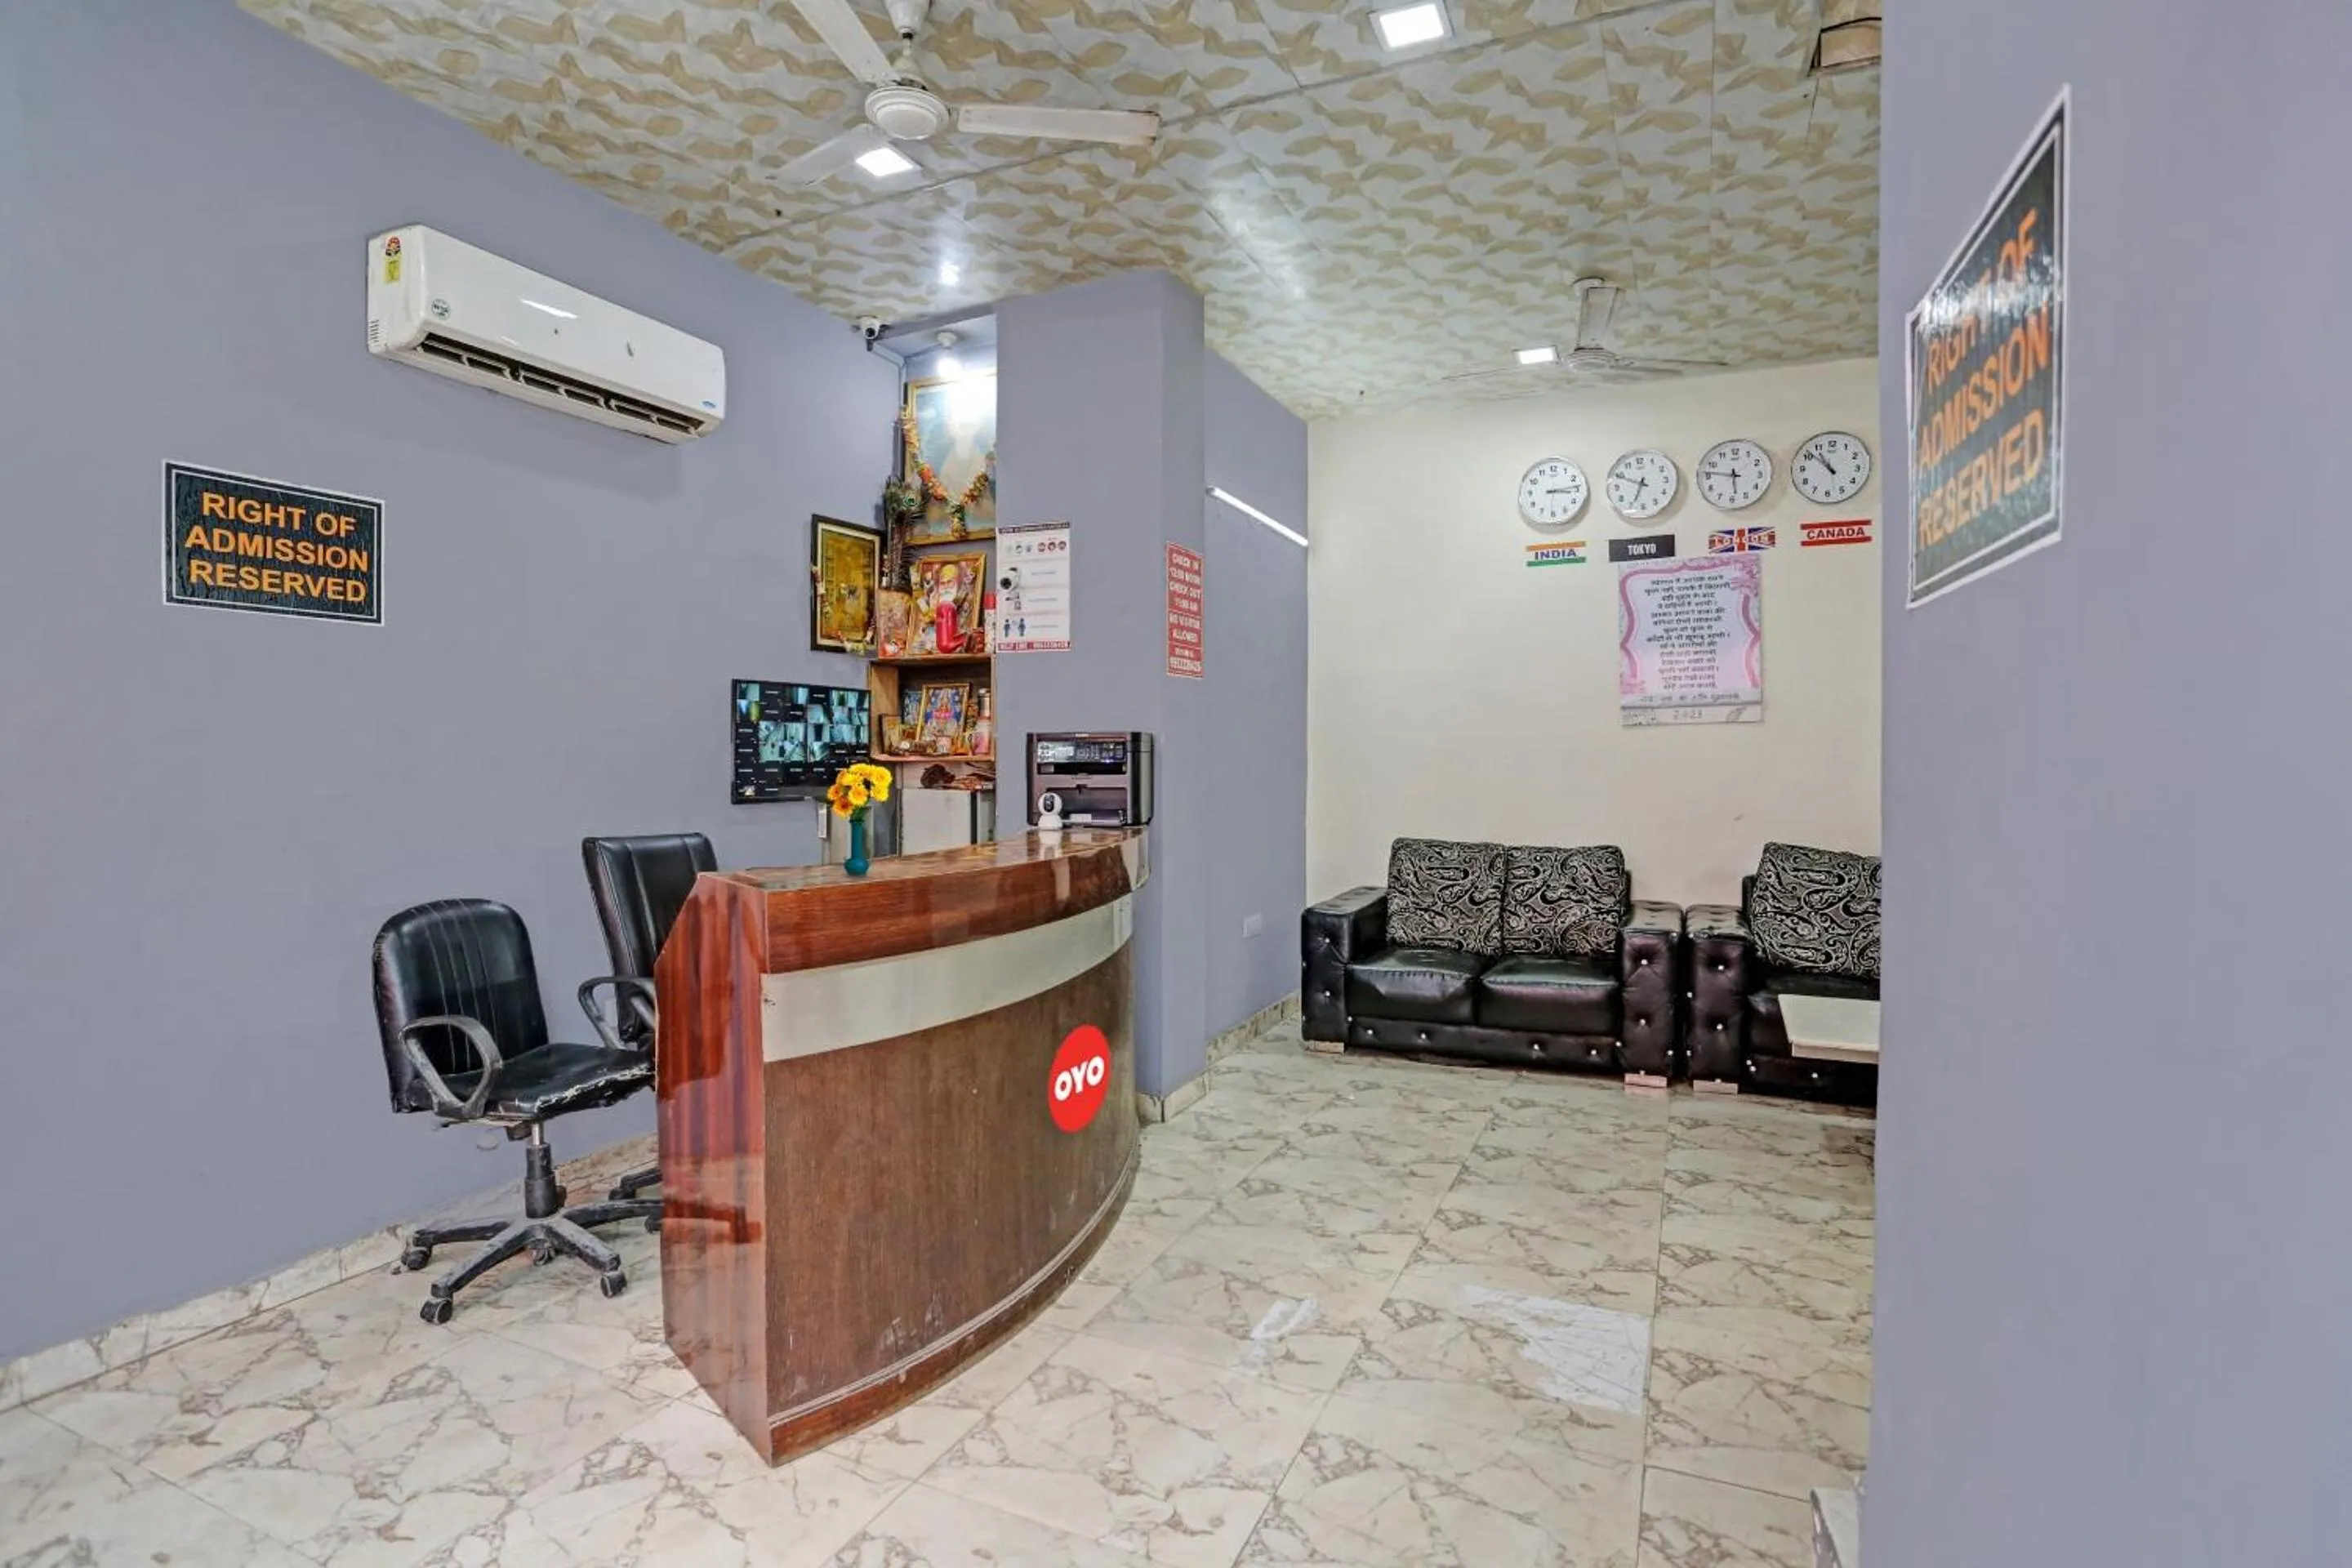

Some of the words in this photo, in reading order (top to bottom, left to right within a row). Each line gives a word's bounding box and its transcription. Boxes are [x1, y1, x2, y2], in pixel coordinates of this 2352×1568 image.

[1919, 300, 2050, 479] ADMISSION
[1731, 448, 1740, 456] 12
[1919, 408, 2043, 552] RESERVED
[202, 492, 306, 531] RIGHT
[315, 513, 356, 537] OF
[1806, 527, 1865, 540] CANADA
[185, 525, 368, 572] ADMISSION
[1535, 548, 1576, 559] INDIA
[1628, 543, 1656, 555] TOKYO
[189, 559, 367, 601] RESERVED
[1054, 1055, 1105, 1101] OYO
